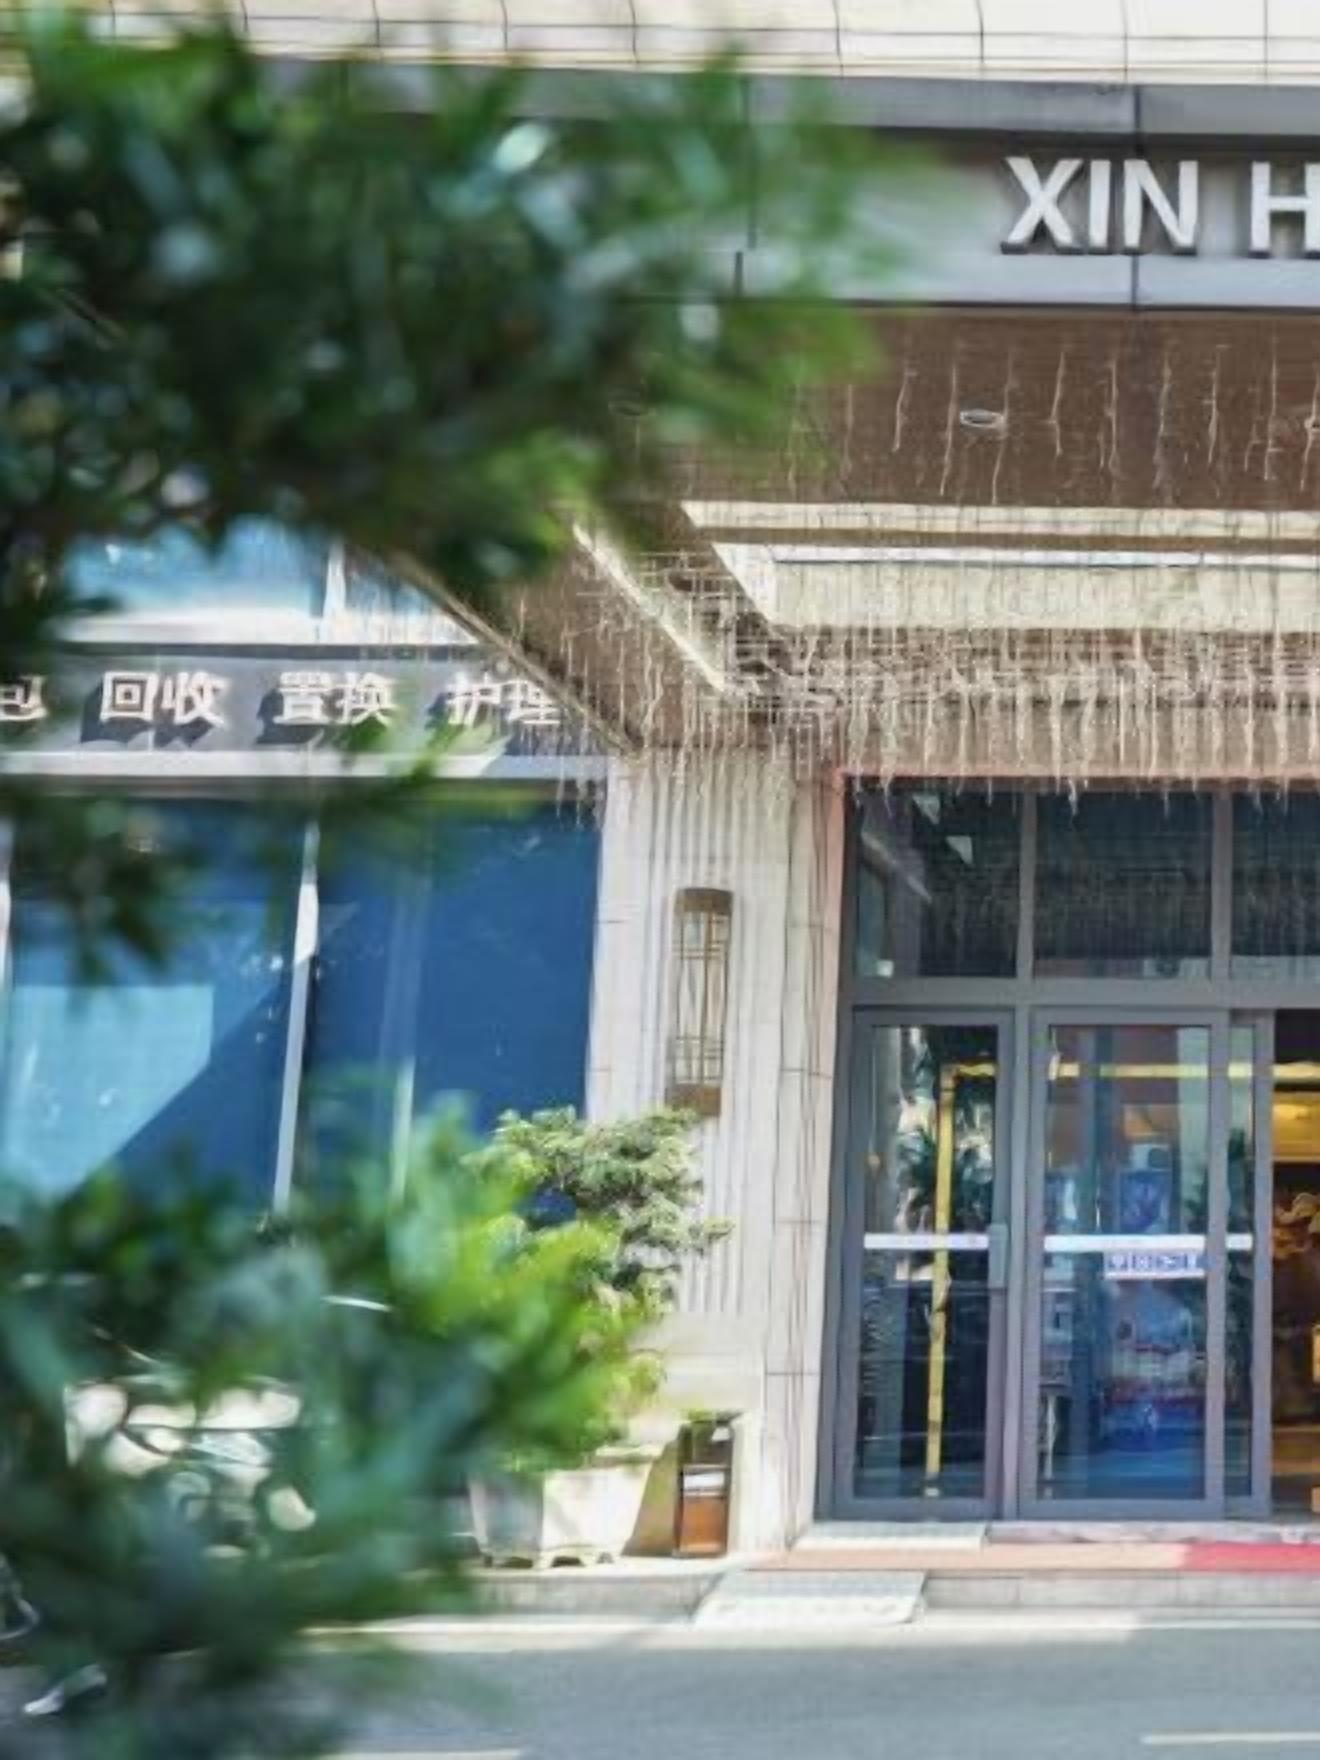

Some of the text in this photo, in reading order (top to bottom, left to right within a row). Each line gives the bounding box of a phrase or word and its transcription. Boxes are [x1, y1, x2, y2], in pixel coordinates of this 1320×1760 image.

[1001, 156, 1198, 254] XIN
[100, 671, 228, 726] 回收
[275, 670, 398, 726] 置换
